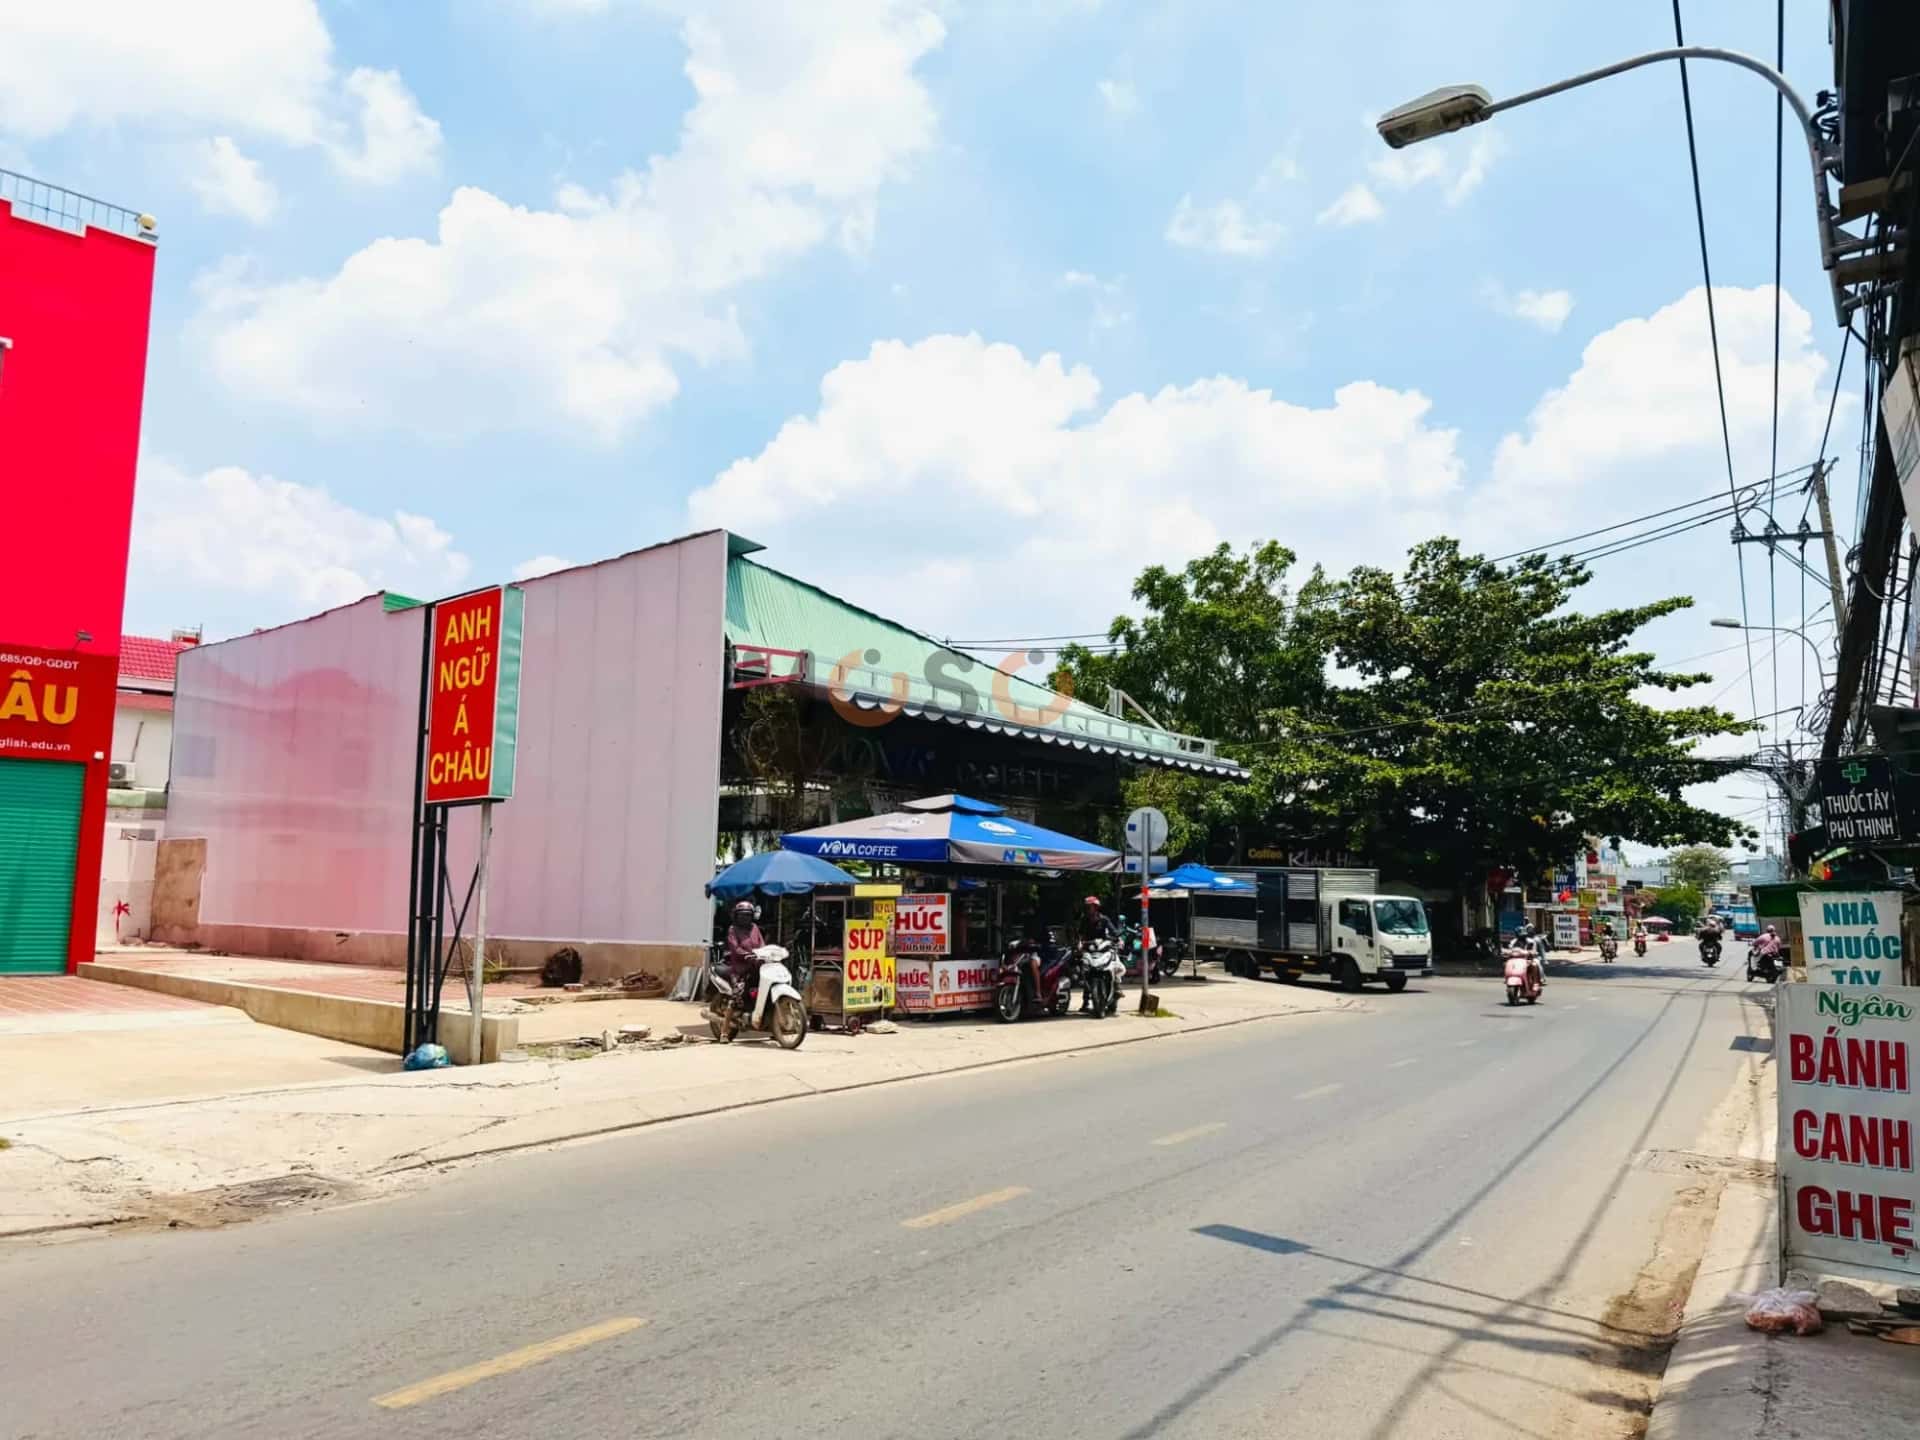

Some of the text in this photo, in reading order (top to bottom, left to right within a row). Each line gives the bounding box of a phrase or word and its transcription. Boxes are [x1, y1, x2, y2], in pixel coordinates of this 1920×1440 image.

[444, 605, 492, 646] ANH
[440, 646, 492, 692] NGỮ
[0, 669, 79, 725] ÂU
[453, 694, 469, 736] Á
[430, 740, 491, 785] CHÂU
[1825, 787, 1890, 815] THUỐC TÂY
[1855, 817, 1895, 840] THỊNH
[857, 843, 899, 857] COFFEE
[1823, 897, 1879, 926] NHÀ
[848, 922, 884, 951] SÚP
[1809, 927, 1901, 961] THUỐC
[847, 958, 882, 982] CUA
[1817, 990, 1912, 1026] Ngân
[1789, 1025, 1911, 1094] BÁNH
[1793, 1108, 1913, 1172] CANH
[1796, 1184, 1918, 1261] GHẸ
